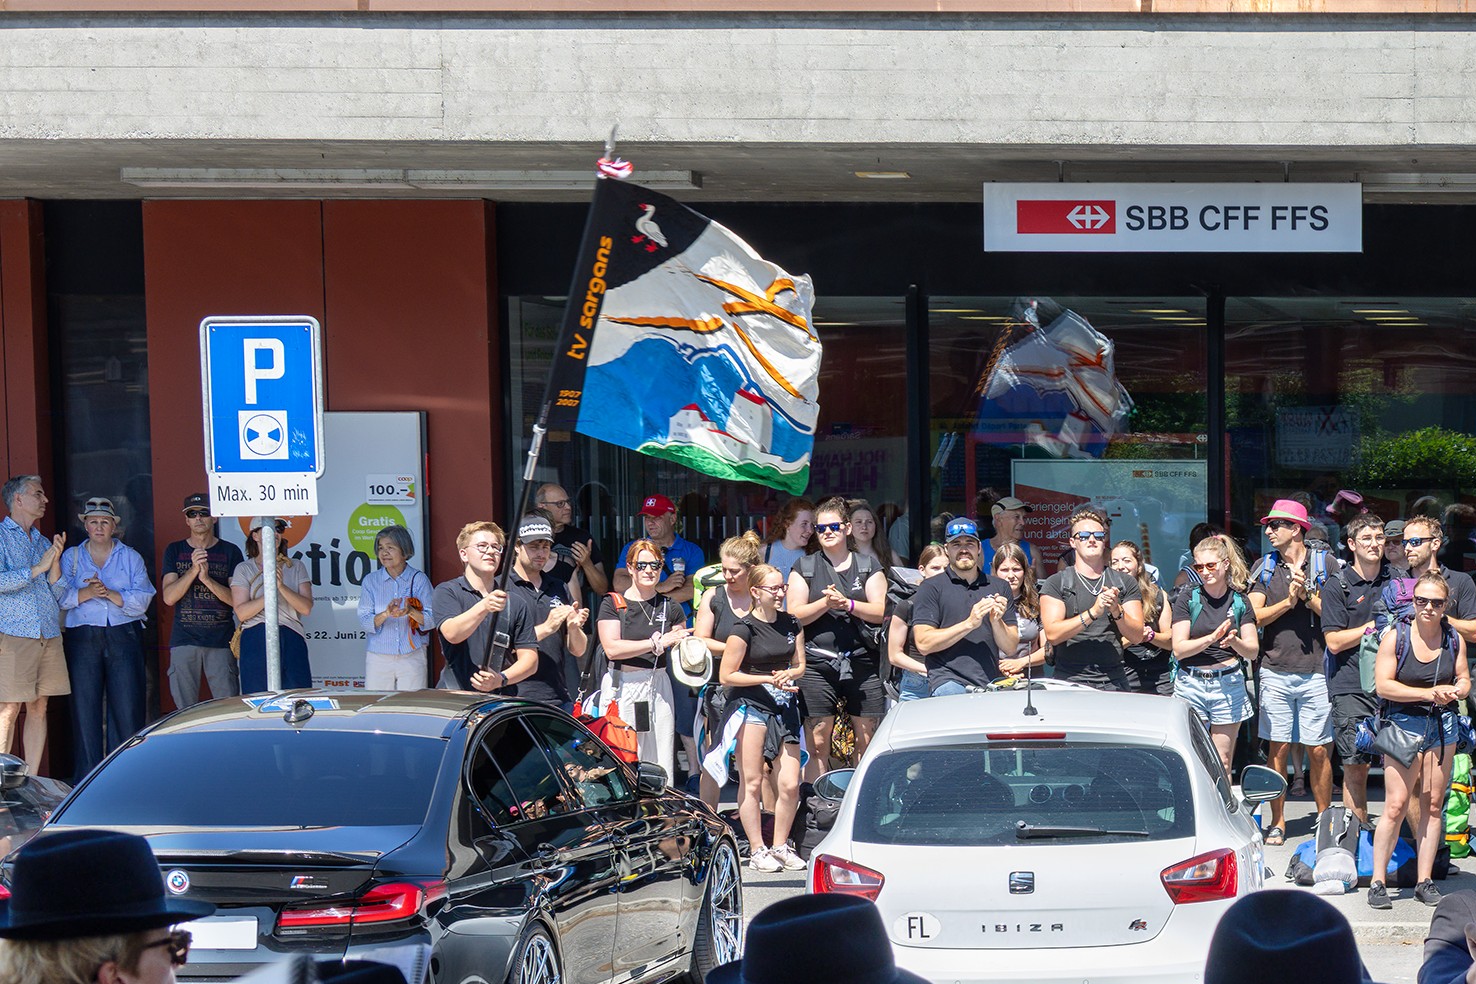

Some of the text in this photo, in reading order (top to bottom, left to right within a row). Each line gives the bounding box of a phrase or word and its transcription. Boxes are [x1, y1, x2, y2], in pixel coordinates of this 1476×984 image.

[1125, 205, 1330, 231] SBB CFF FFS
[566, 235, 613, 360] tv sargans
[243, 338, 285, 404] P
[558, 390, 582, 398] 1907
[556, 398, 580, 407] 2007
[217, 484, 309, 502] Max. 30 min
[359, 516, 396, 526] Gratis
[1024, 516, 1070, 525] wechseln
[1024, 531, 1043, 539] und
[314, 631, 332, 640] 22.
[334, 631, 357, 640] Juni
[908, 916, 930, 939] FL
[981, 923, 1064, 933] IBIZA
